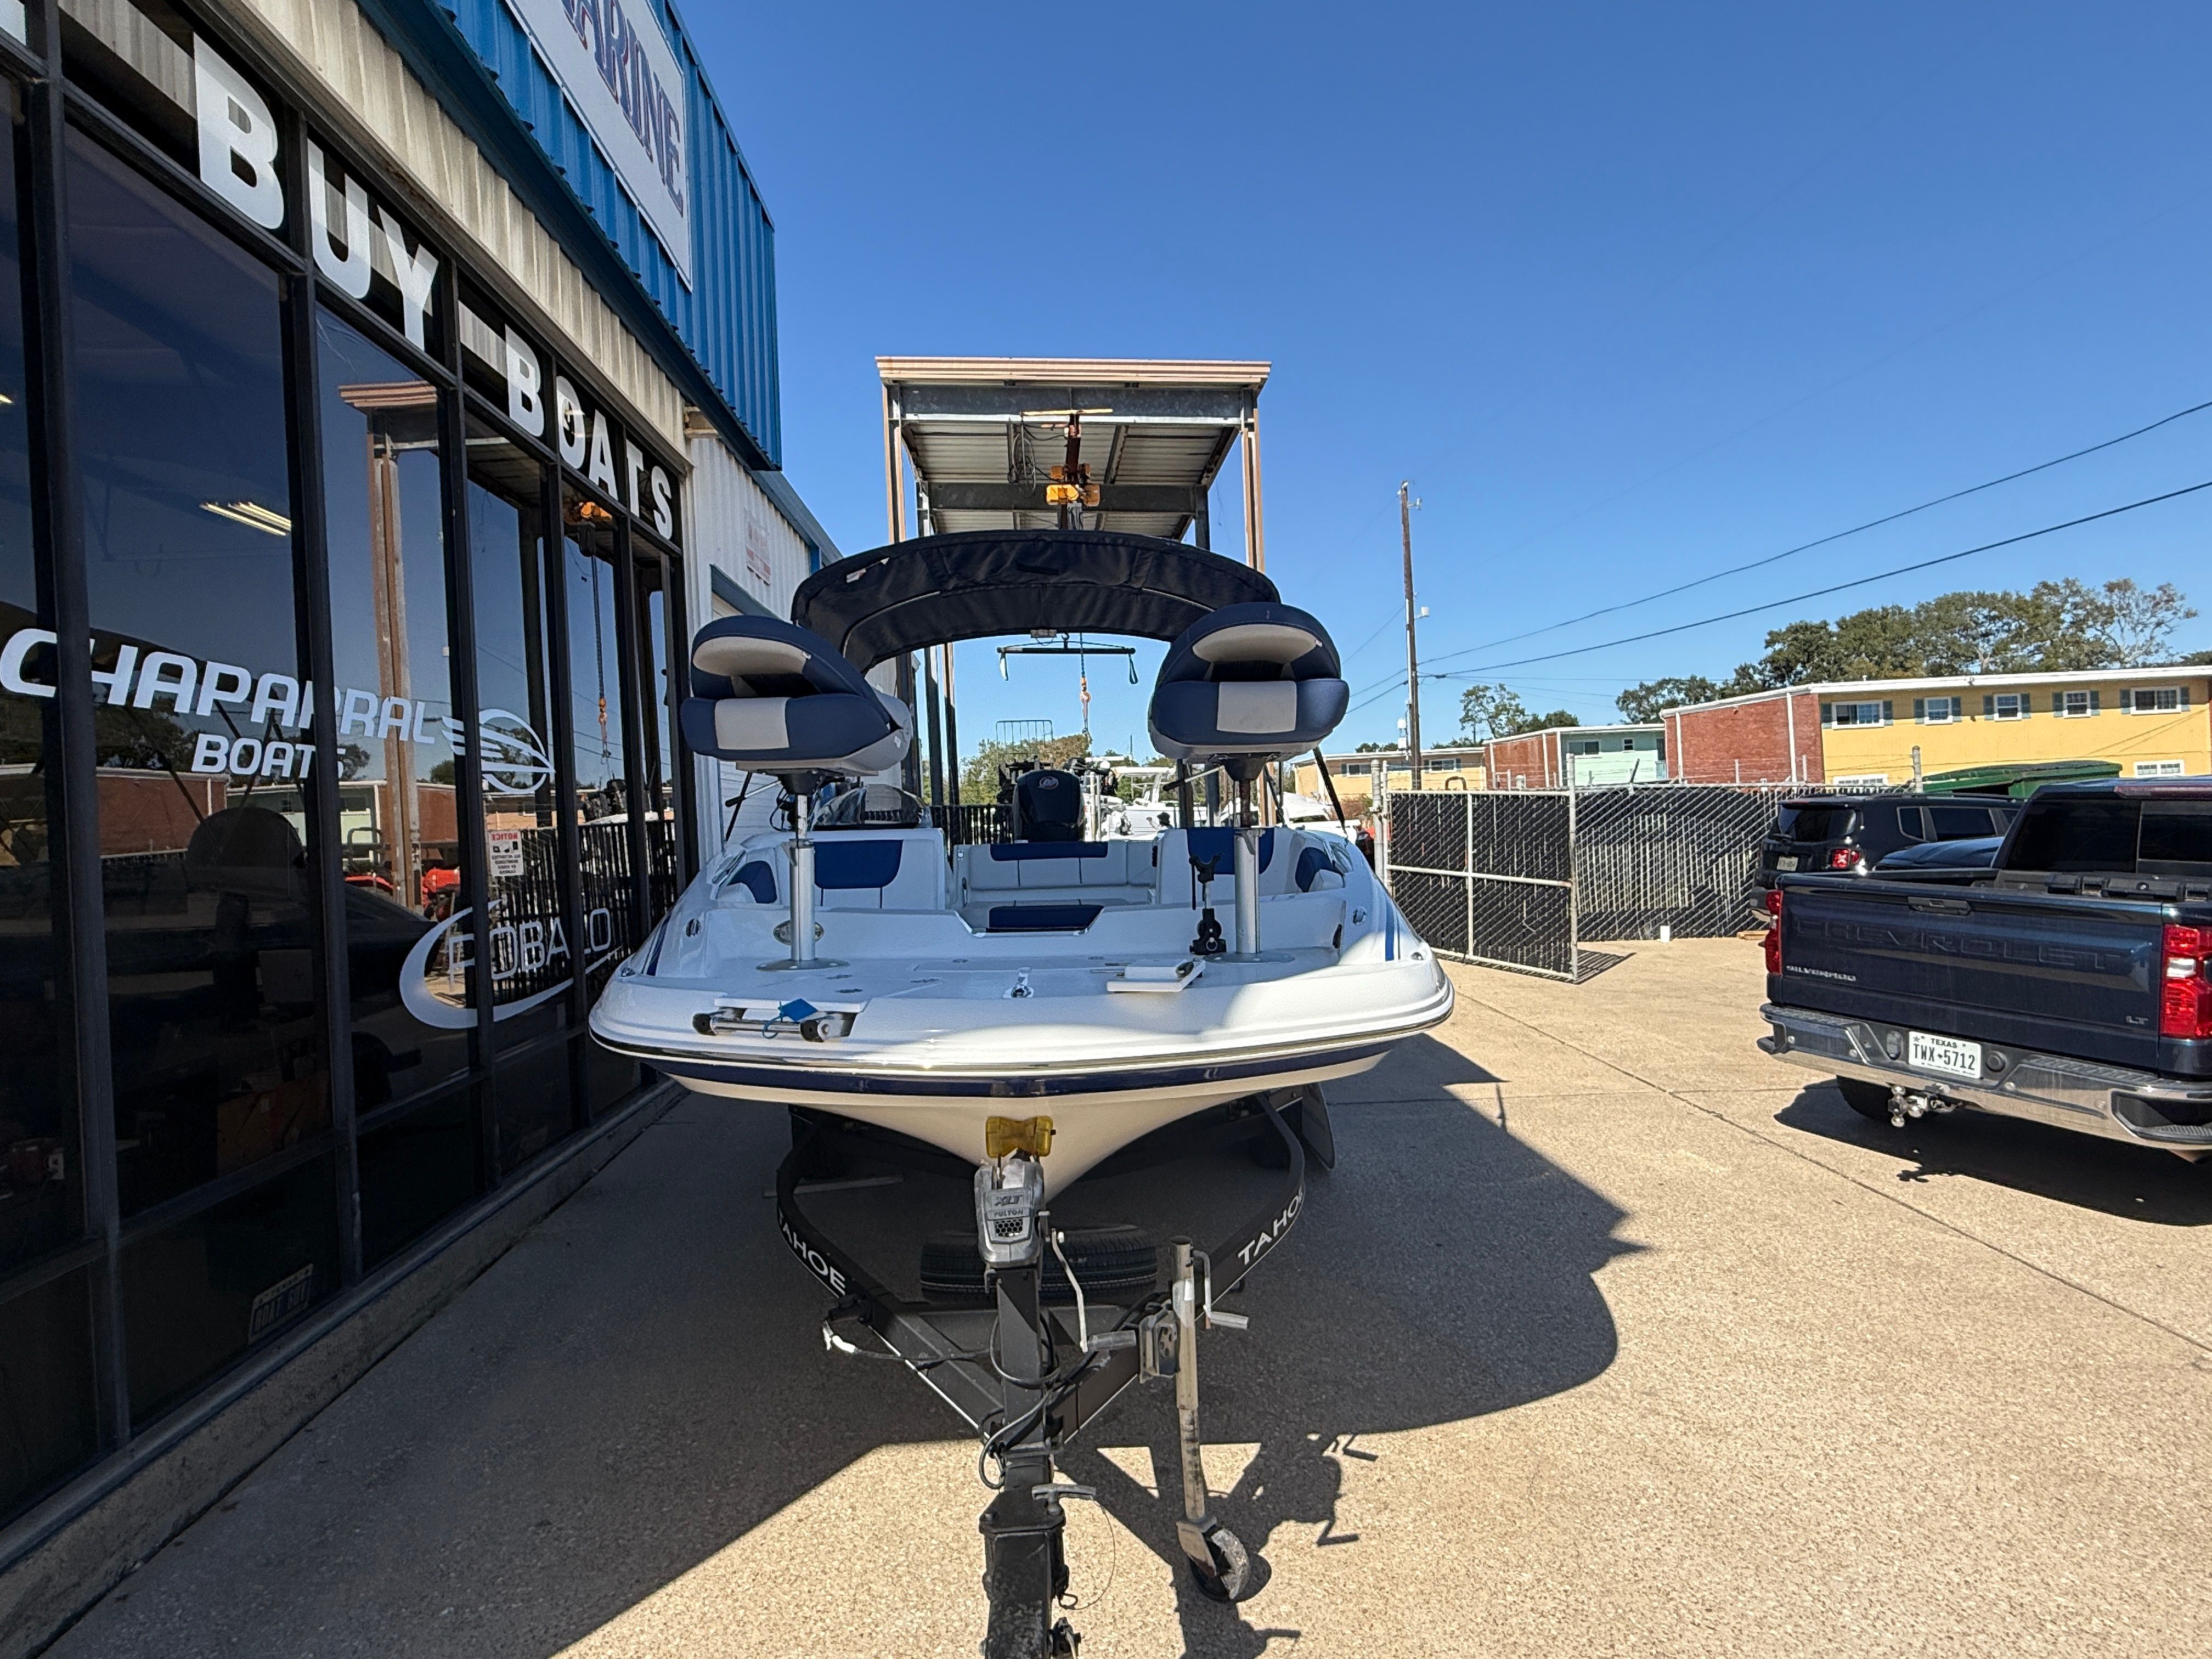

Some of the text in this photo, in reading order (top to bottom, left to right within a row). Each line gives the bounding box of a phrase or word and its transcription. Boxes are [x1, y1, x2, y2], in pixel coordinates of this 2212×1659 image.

[193, 31, 672, 540] BUY BOATS
[449, 908, 611, 989] ROBAO
[1797, 919, 2121, 970] CHEVROLET
[1786, 966, 1857, 981] SILVERADO
[2125, 1015, 2149, 1025] LT
[1931, 1038, 1957, 1049] TEXAS
[994, 1195, 1023, 1206] XLT
[994, 1209, 1023, 1217] FULTON
